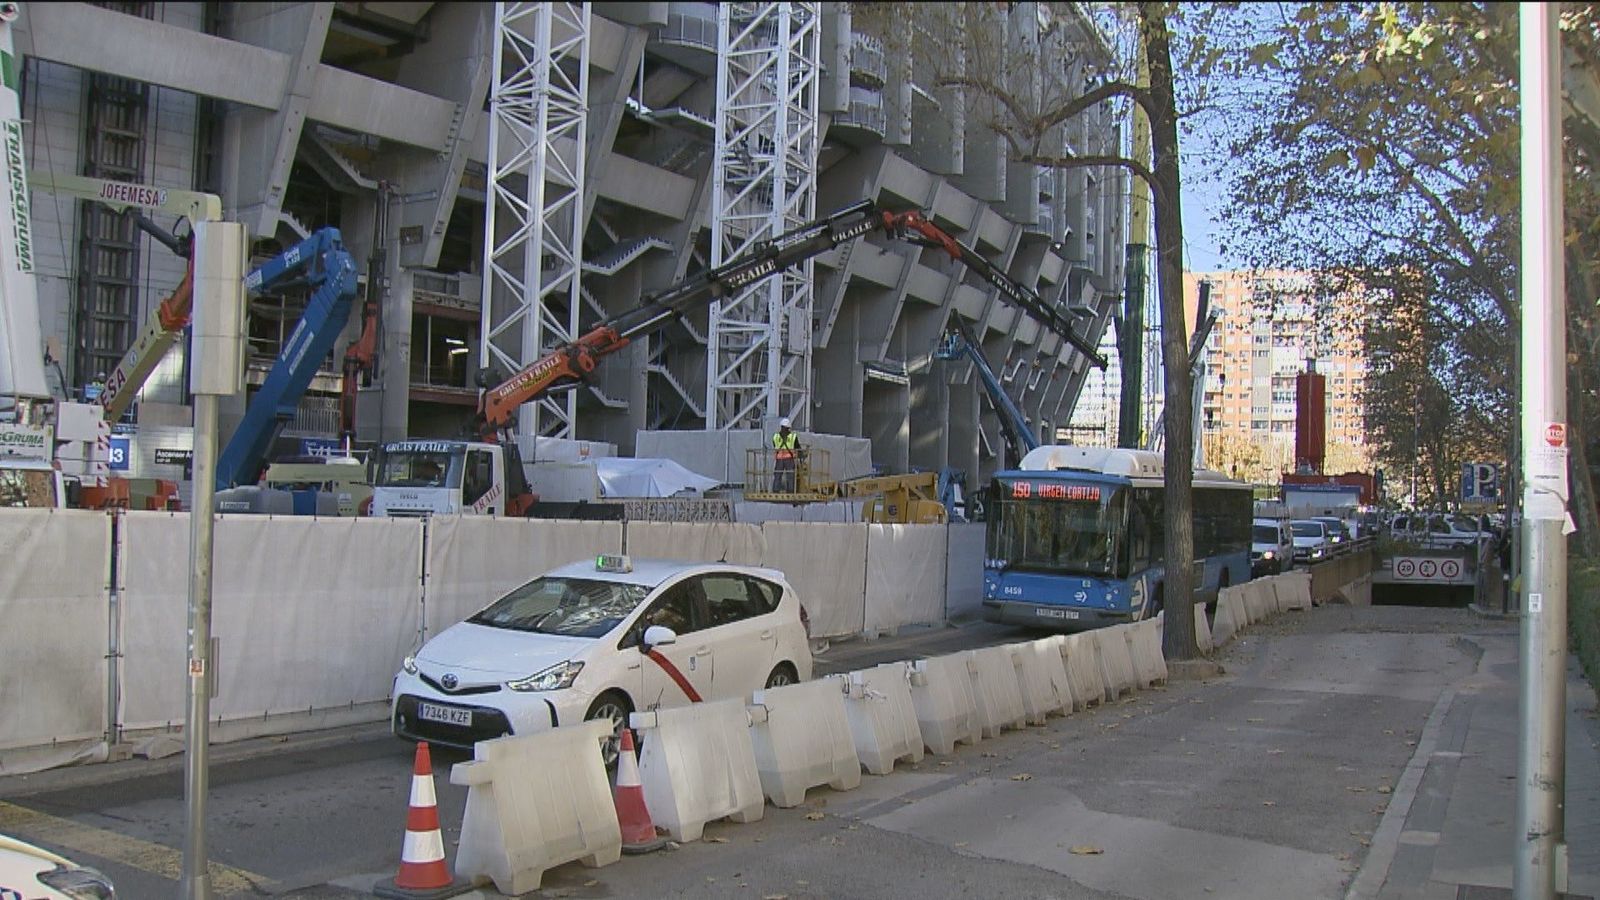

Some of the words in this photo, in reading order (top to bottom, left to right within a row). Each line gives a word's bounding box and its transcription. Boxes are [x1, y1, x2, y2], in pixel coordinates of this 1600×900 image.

[8, 122, 32, 271] TRANSGRUMA
[100, 183, 159, 206] JOFEMESA
[728, 259, 776, 288] FRAILE
[1012, 481, 1031, 498] 150
[1067, 485, 1100, 501] CORTIJO
[1472, 463, 1496, 498] P
[473, 483, 503, 515] FRAILE
[425, 705, 448, 720] 7346
[450, 709, 470, 724] KZF
